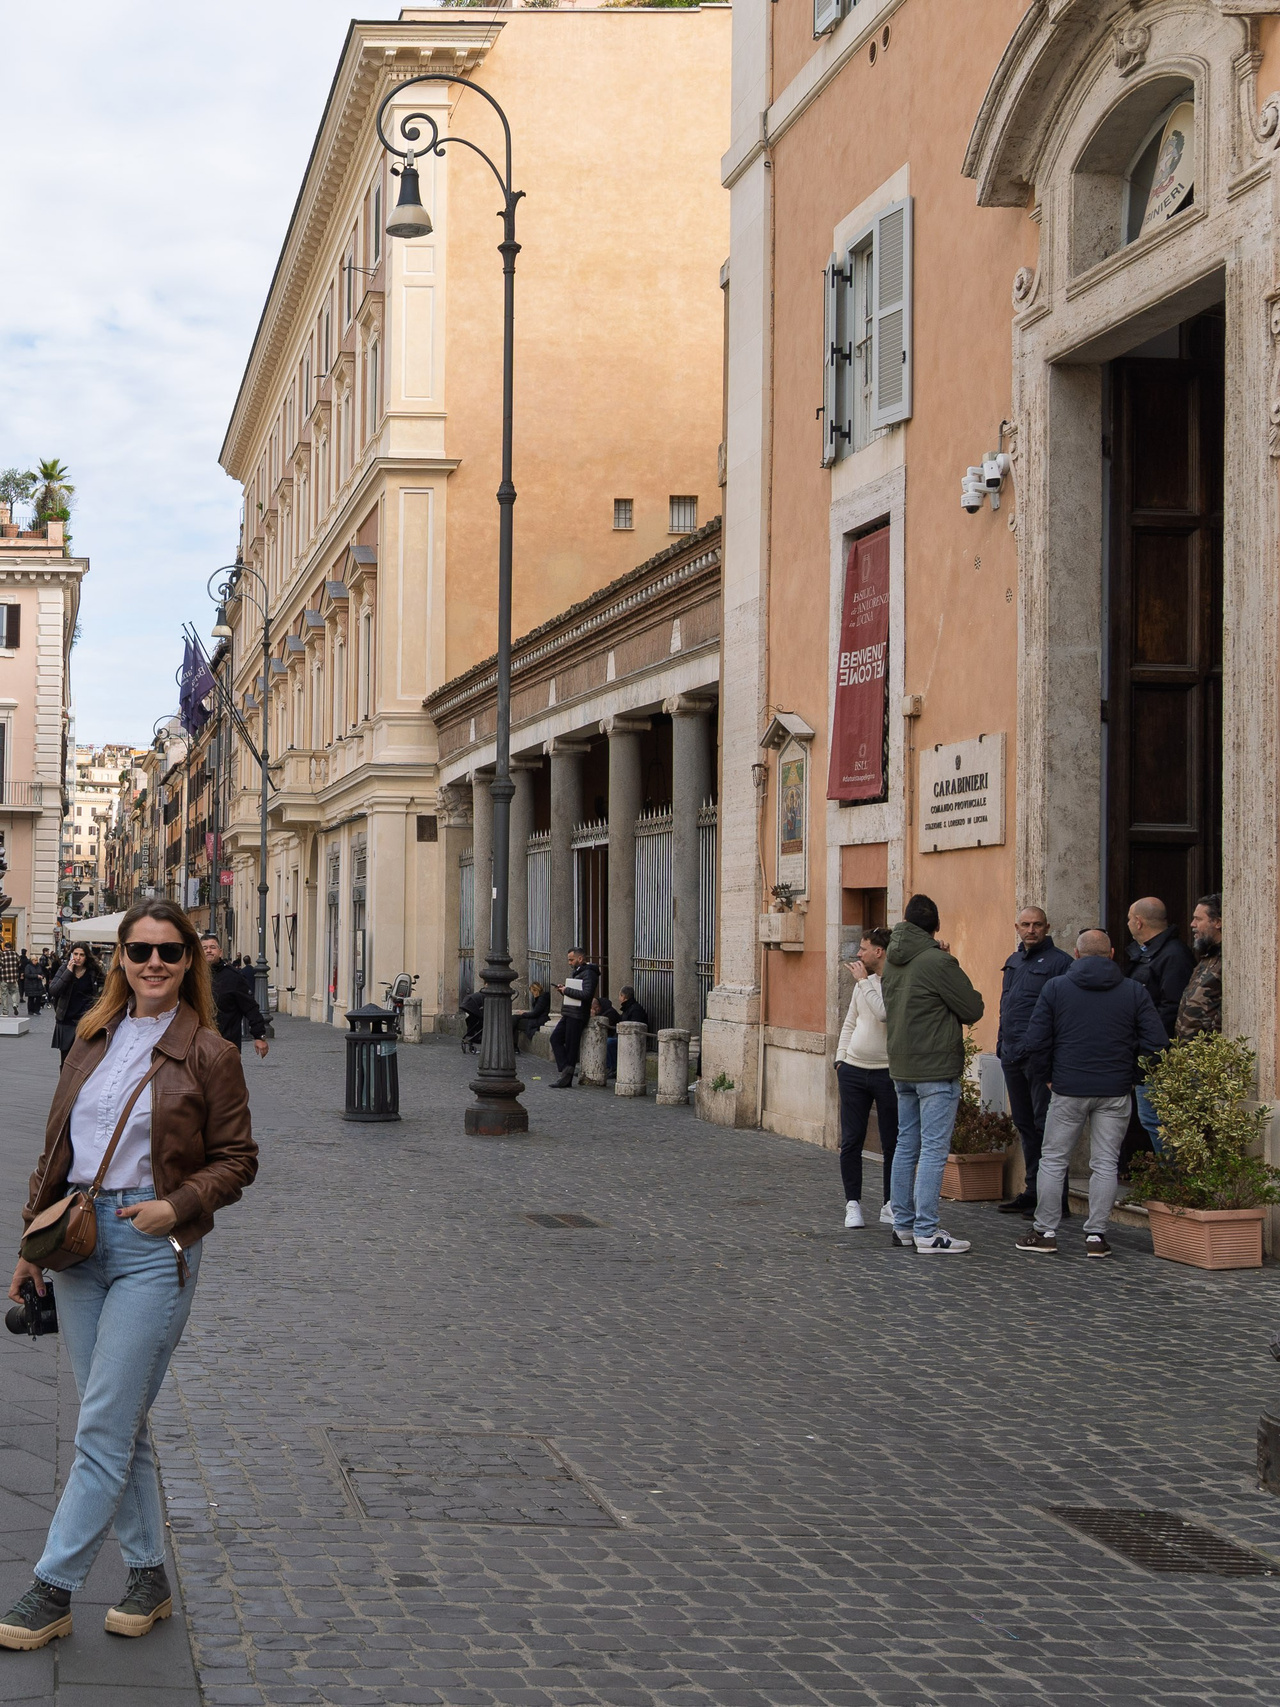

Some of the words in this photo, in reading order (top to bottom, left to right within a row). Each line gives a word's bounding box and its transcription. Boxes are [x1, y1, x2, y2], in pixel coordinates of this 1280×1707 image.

[933, 772, 988, 798] CARABINIERI
[930, 802, 954, 815] COMANDO
[954, 797, 987, 811] PROVINCIALE
[924, 821, 942, 831] STAZIONE
[948, 818, 965, 828] LORENZO
[967, 817, 972, 825] IN
[973, 815, 988, 824] LUCINA
